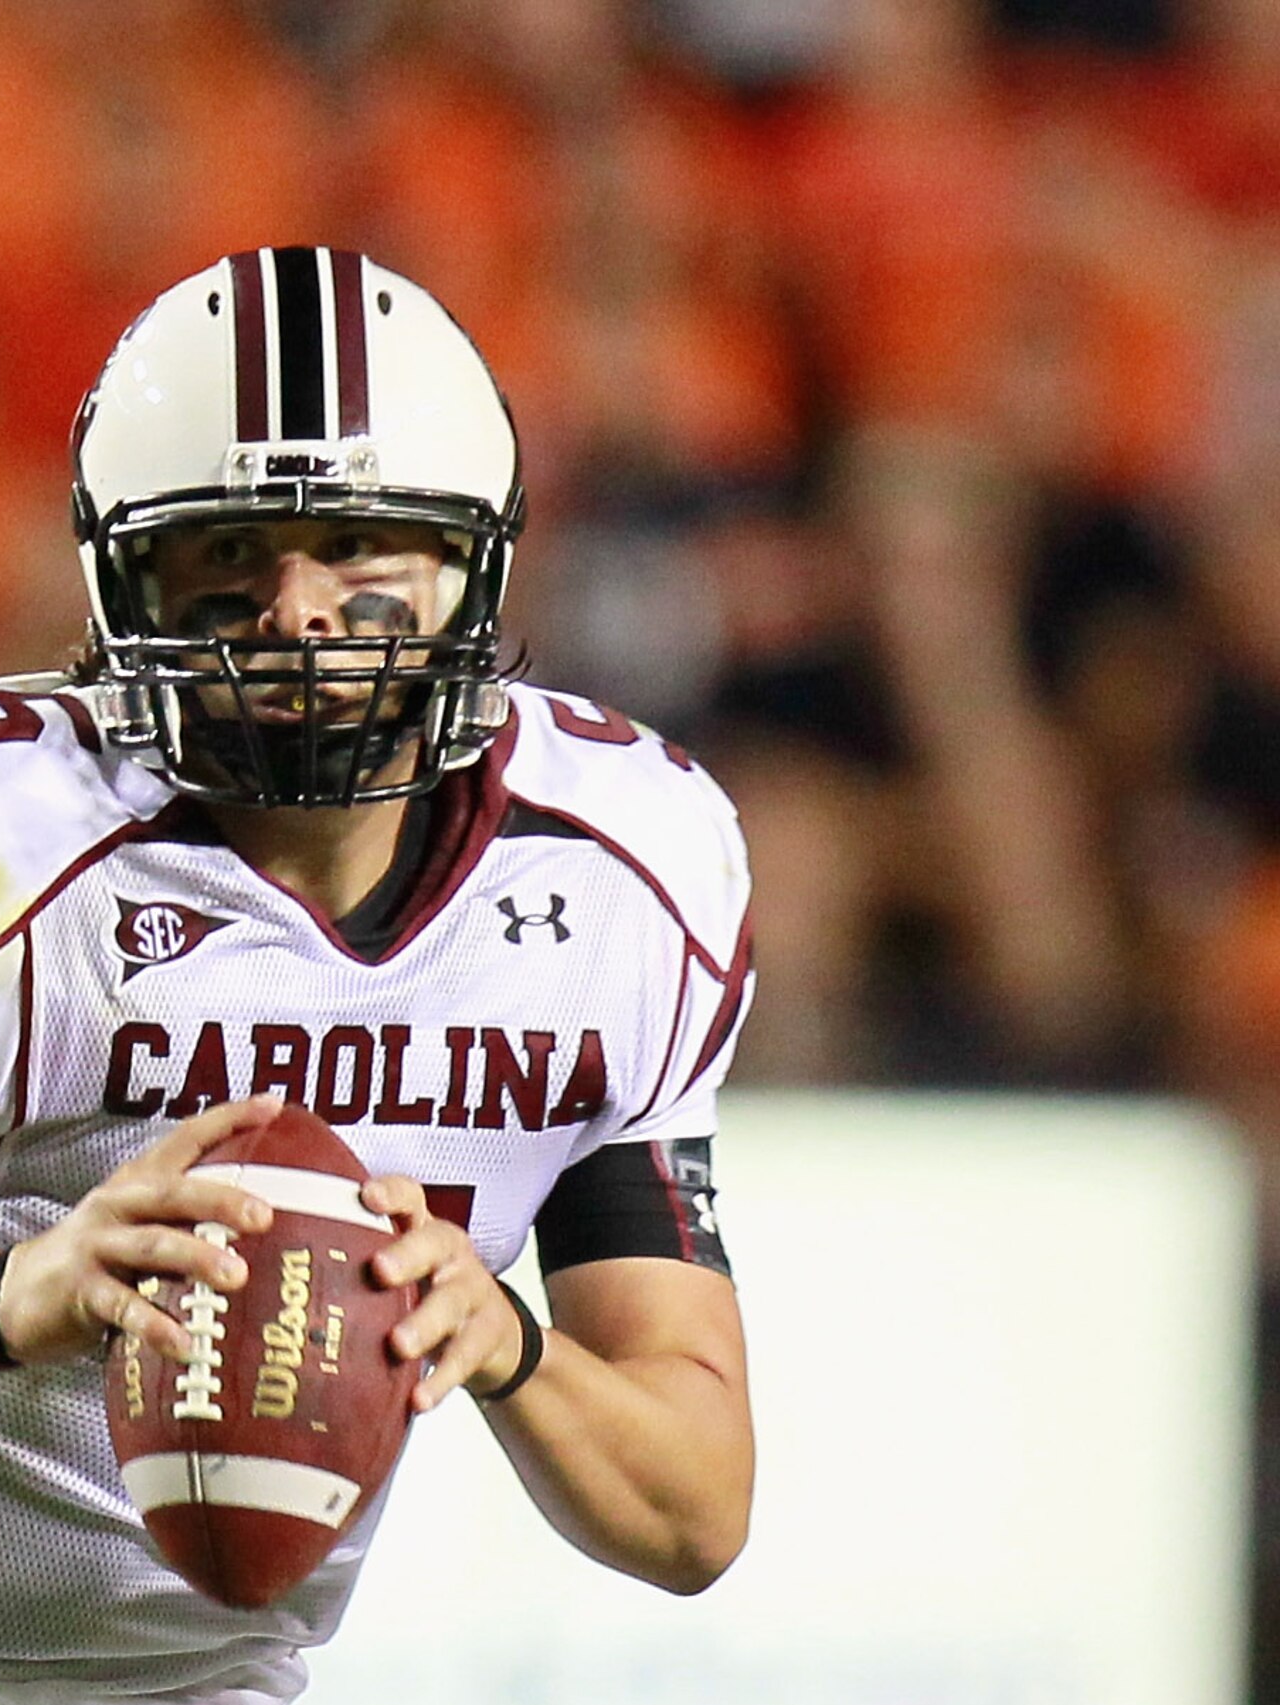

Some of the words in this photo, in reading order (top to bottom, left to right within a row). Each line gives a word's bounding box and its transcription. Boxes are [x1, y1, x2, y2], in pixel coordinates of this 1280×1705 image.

[133, 907, 186, 959] SEC
[102, 1021, 608, 1132] CAROLINA
[252, 1248, 312, 1418] Wilson
